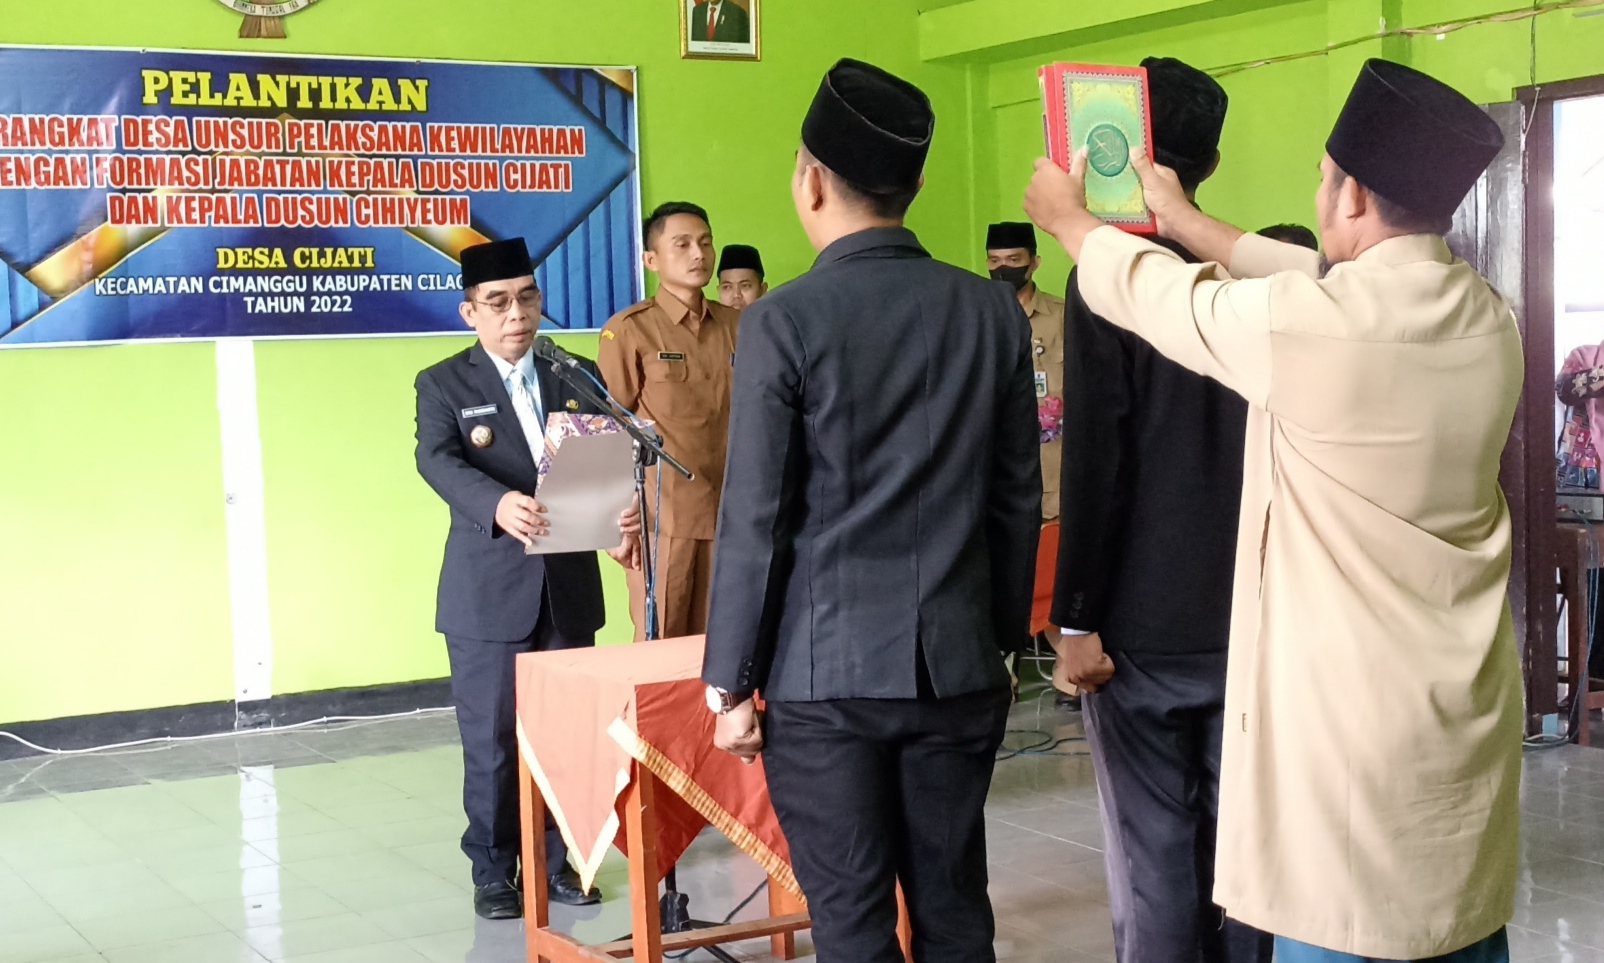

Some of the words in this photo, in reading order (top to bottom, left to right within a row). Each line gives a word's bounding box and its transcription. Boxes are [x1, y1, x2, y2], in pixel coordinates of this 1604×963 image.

[142, 69, 429, 112] PELANTIKAN
[122, 116, 191, 149] DESA
[195, 117, 282, 151] UNSUR
[287, 120, 424, 154] PELAKSANA
[428, 125, 585, 156] KEWILAYAHAN
[0, 155, 90, 188] ENGAN
[95, 156, 210, 188] FORMASI
[215, 157, 323, 190] JABATAN
[328, 158, 417, 191] KEPALA
[419, 160, 499, 191] DUSUN
[503, 161, 572, 192] CIJATI
[107, 193, 158, 226] DAN
[165, 193, 260, 226] KEPALA
[264, 194, 350, 227] DUSUN
[354, 195, 470, 227] CIHIYEUM
[216, 247, 287, 269] DESA
[293, 247, 375, 269] CIJATI
[94, 276, 203, 296] KECAMATAN
[208, 275, 307, 294] CIMANGGU
[312, 274, 413, 292] KABUPATEN
[243, 296, 305, 314] TAHUN
[310, 295, 353, 313] 2022
